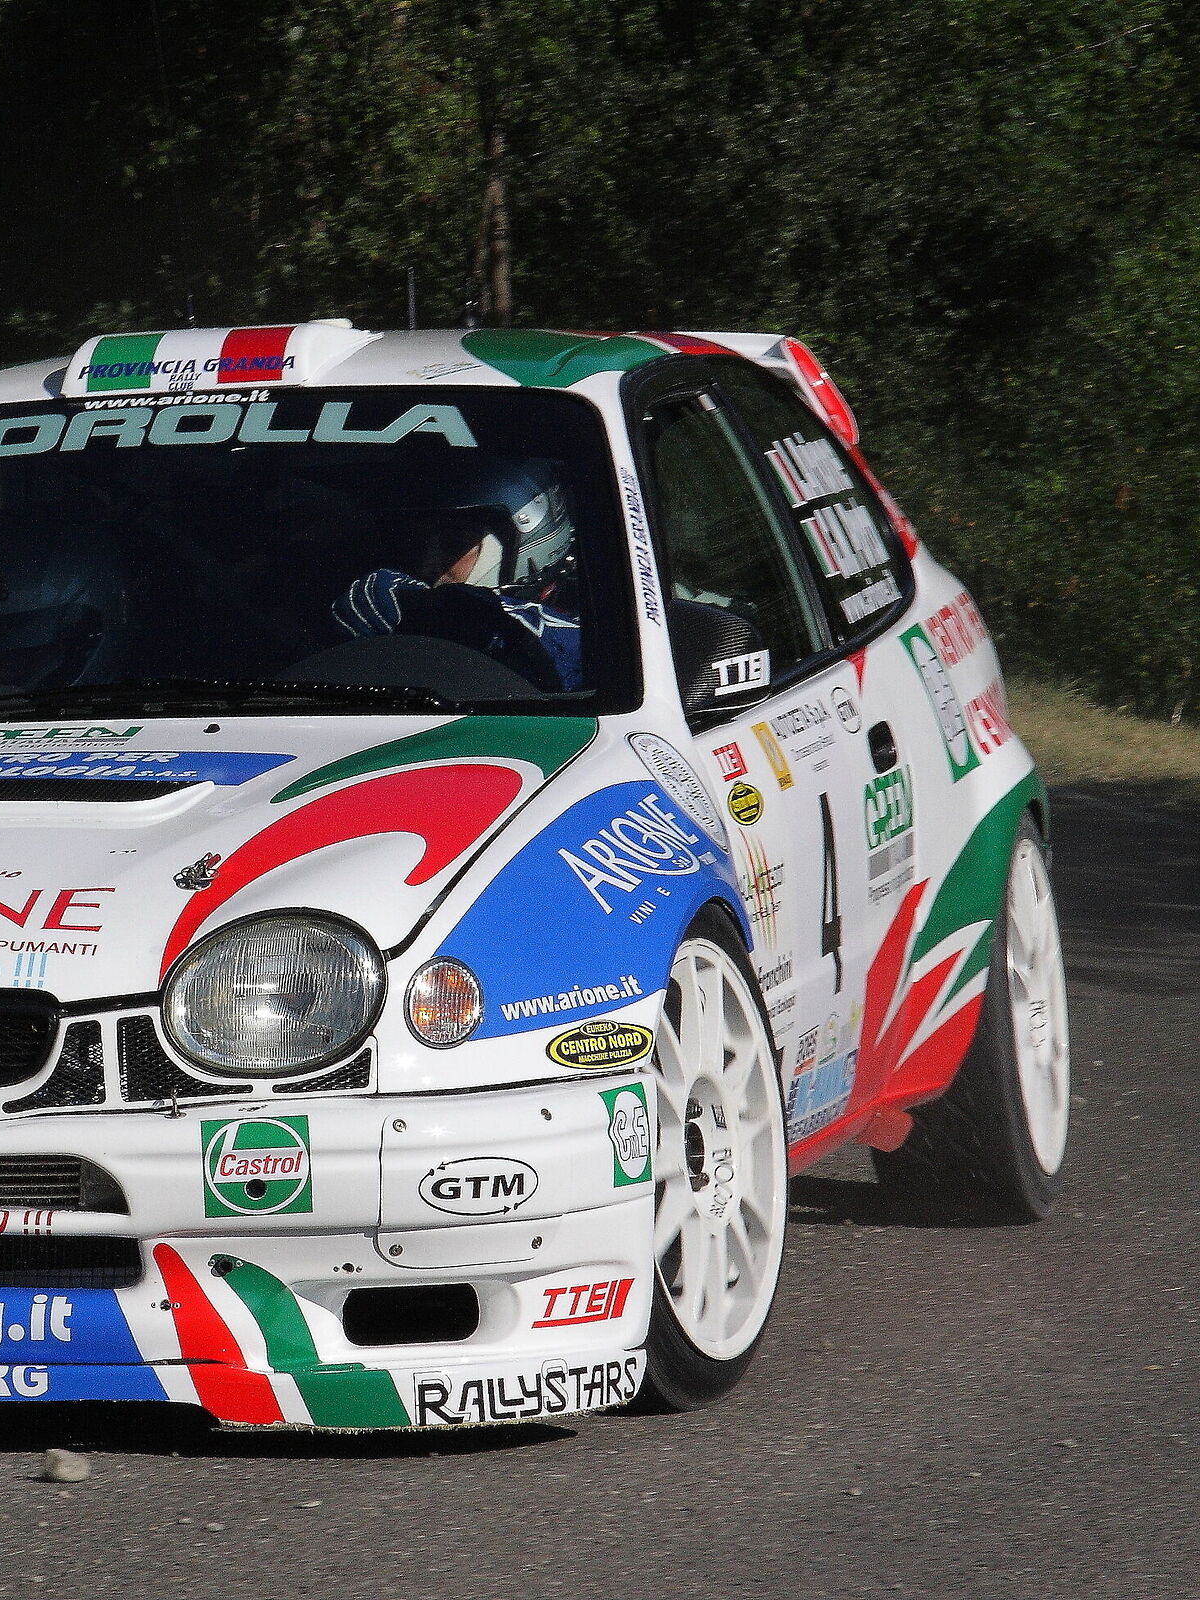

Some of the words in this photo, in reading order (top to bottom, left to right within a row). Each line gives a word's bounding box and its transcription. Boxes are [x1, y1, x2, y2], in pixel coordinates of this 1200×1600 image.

[78, 359, 197, 380] PROVINCIA
[203, 355, 295, 373] GRANDA
[168, 372, 201, 382] RALLY
[83, 389, 271, 410] www.arione.it
[167, 381, 194, 391] CLUB
[711, 651, 767, 692] TTE
[83, 752, 181, 763] PER
[557, 793, 700, 915] ARIONE
[629, 899, 657, 926] VINI
[656, 886, 671, 898] E
[818, 792, 842, 995] 4
[11, 951, 49, 989] !!!
[500, 974, 643, 1022] www.arione.it
[585, 1022, 614, 1034] EUREKA
[560, 1036, 607, 1056] CENTRO
[608, 1031, 643, 1050] NORD
[219, 1151, 303, 1177] Castrol
[430, 1172, 526, 1200] GTM
[540, 1280, 622, 1323] TTE
